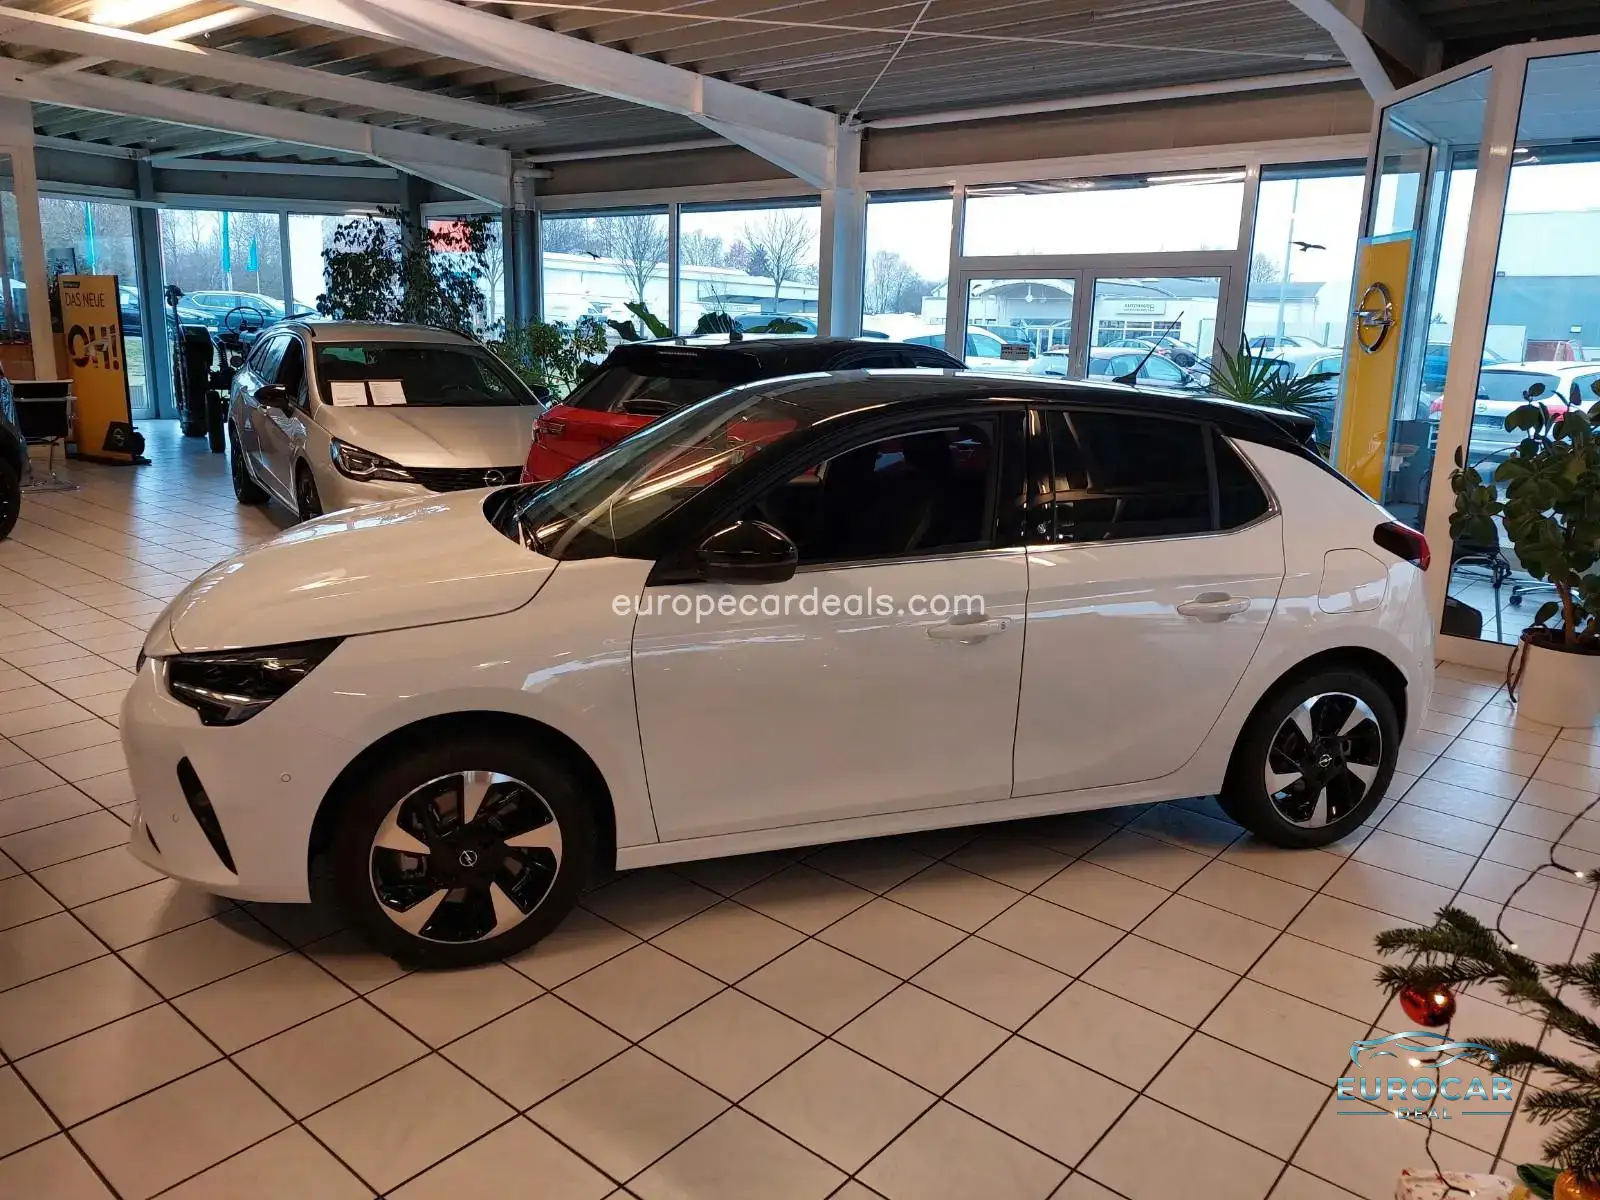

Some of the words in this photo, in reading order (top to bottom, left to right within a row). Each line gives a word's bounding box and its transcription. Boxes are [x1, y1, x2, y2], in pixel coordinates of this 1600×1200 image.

[65, 292, 81, 307] DAS
[82, 292, 105, 307] NEUE
[67, 324, 120, 370] OH!
